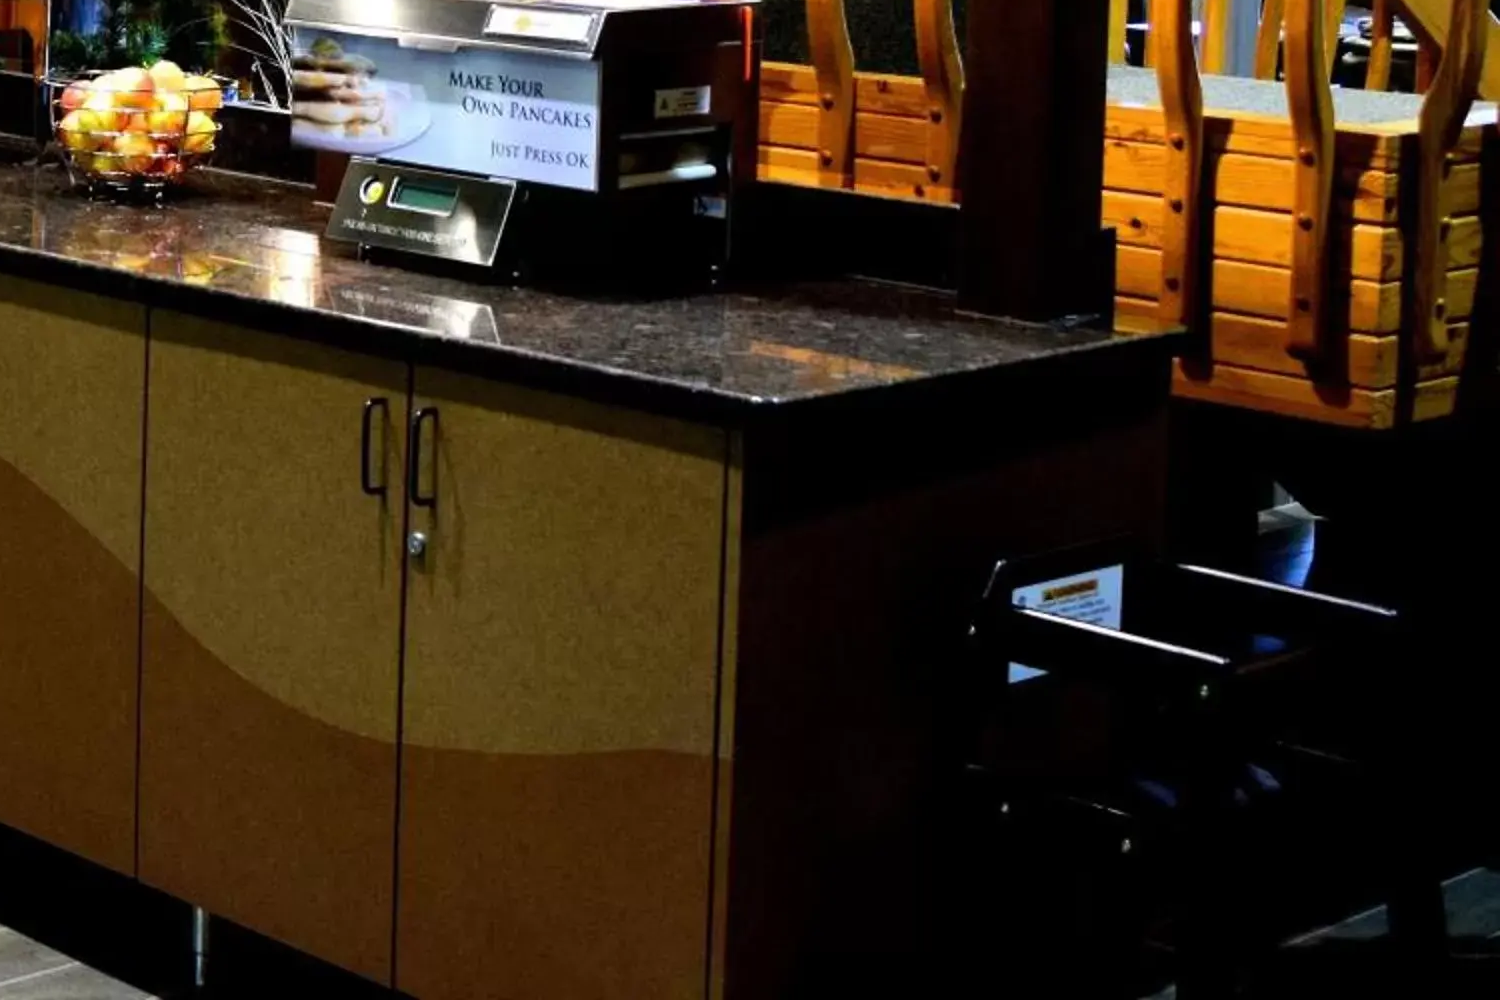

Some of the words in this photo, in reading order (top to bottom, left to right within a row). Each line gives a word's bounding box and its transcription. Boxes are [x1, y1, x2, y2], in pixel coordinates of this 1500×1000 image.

[449, 70, 493, 91] MAKE
[498, 74, 544, 98] YOUR
[462, 95, 503, 116] OWN
[510, 101, 591, 128] PANCAKES
[490, 140, 520, 160] JUST
[524, 145, 563, 165] PRESS
[566, 151, 589, 168] OK
